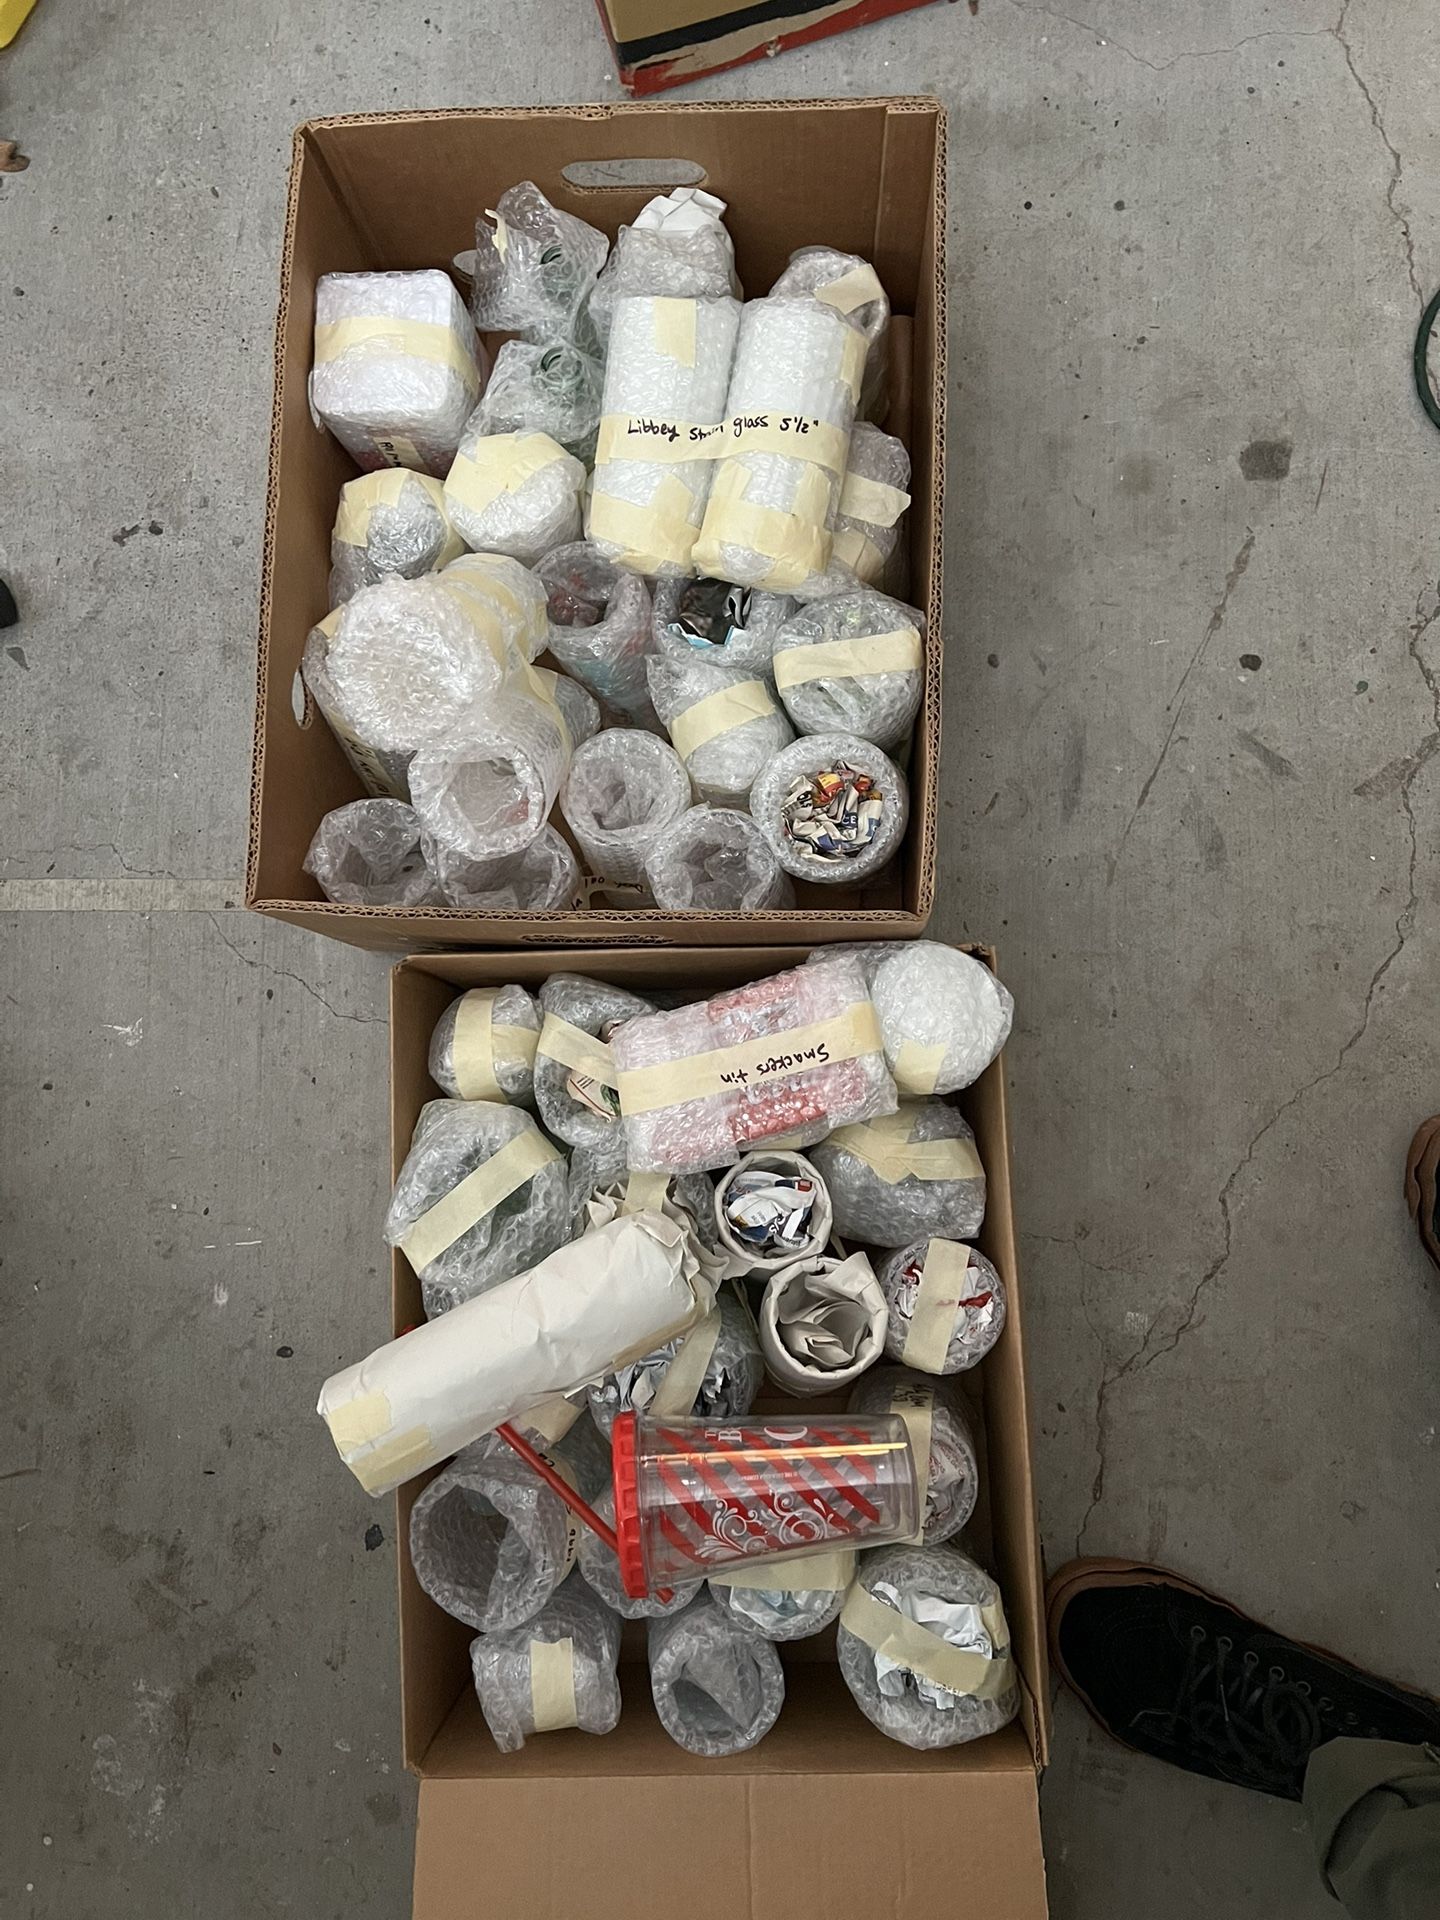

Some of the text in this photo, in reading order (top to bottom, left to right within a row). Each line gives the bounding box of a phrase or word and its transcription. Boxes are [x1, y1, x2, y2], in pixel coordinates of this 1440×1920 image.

[627, 419, 681, 443] Libbey
[733, 415, 769, 438] glass
[720, 1042, 830, 1083] Smackers tin
